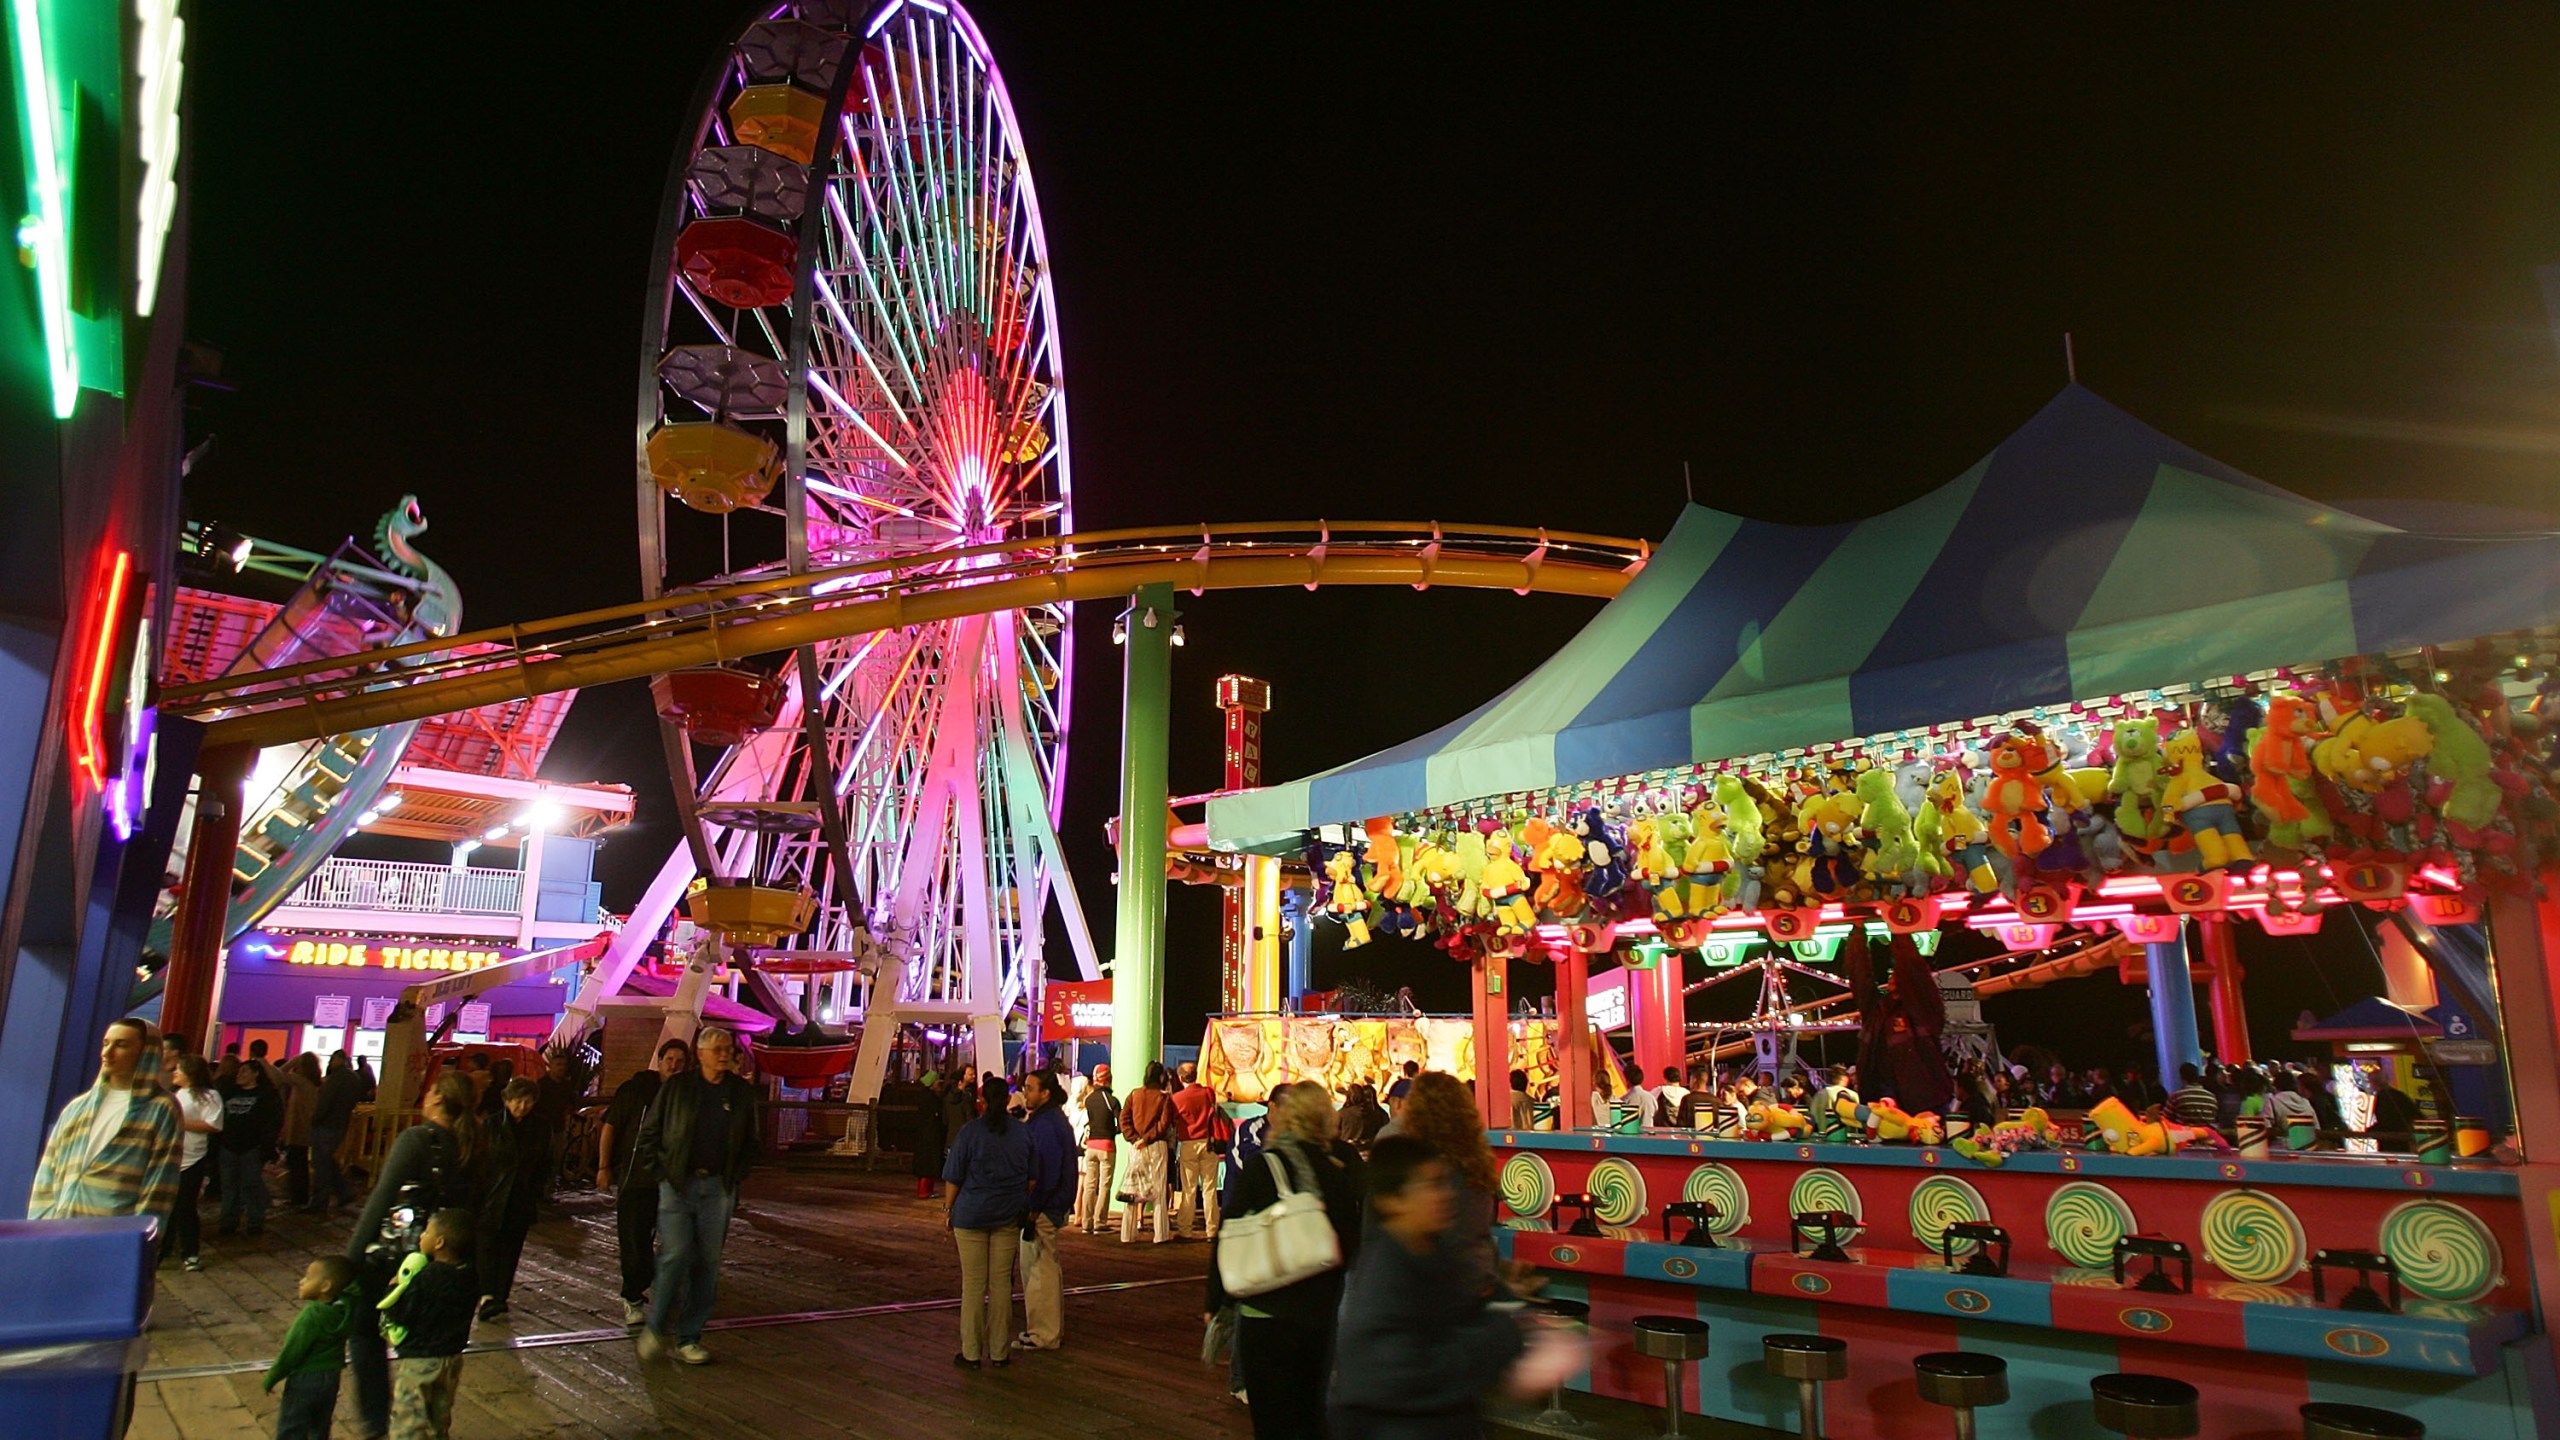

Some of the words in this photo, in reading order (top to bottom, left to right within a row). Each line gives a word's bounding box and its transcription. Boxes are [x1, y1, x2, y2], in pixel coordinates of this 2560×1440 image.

[2361, 868, 2376, 887] 1
[2182, 883, 2200, 902] 2
[2029, 896, 2047, 914] 3
[2434, 898, 2463, 916] 16
[1897, 907, 1911, 922] 4
[1779, 914, 1793, 931] 5
[2134, 918, 2158, 934] 14
[1578, 930, 1586, 945] 7
[2012, 927, 2035, 942] 13
[1492, 937, 1503, 950] 8
[289, 941, 367, 966] RIDE
[382, 946, 500, 971] TICKETS
[1629, 949, 1638, 962] 9
[1710, 945, 1727, 960] 10
[1940, 989, 1972, 1000] GUARD
[1071, 1003, 1112, 1015] PACIFI
[1505, 1135, 1513, 1143] 8
[1691, 1144, 1699, 1153] 6
[1801, 1148, 1809, 1158] 5
[1925, 1153, 1934, 1163] 4
[2064, 1159, 2075, 1170] 3
[2225, 1165, 2237, 1177] 2
[2412, 1172, 2422, 1185] 1
[1560, 1249, 1569, 1262] 6
[1676, 1261, 1685, 1275] 5
[1807, 1277, 1816, 1291] 4
[1962, 1293, 1973, 1309] 3
[2140, 1311, 2153, 1329] 2
[2352, 1334, 2361, 1353] 1
